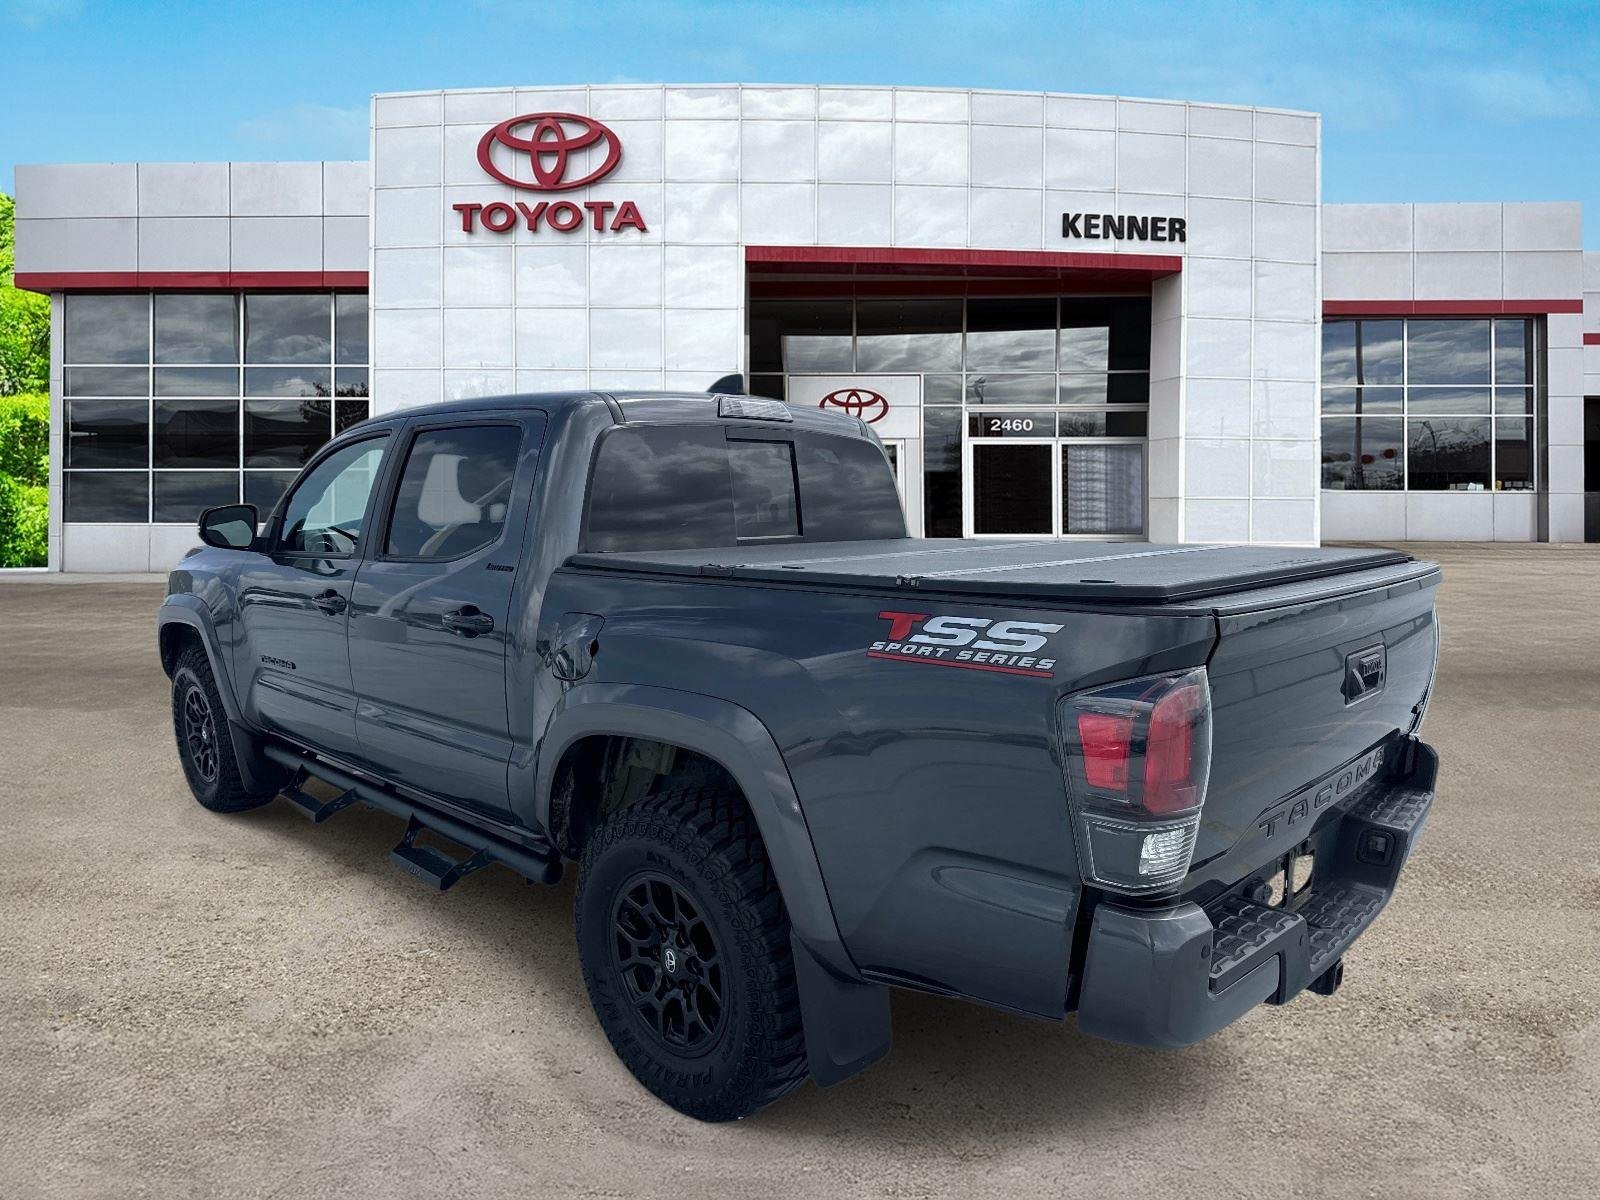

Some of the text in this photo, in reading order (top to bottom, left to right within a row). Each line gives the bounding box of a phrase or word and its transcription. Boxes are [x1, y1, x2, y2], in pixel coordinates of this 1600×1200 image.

[452, 201, 647, 232] TOYOTA
[1062, 213, 1187, 242] KENNER
[990, 418, 1033, 432] 2460
[878, 611, 1065, 653] TSS
[869, 641, 1057, 670] SPORT SERIES
[1258, 748, 1385, 840] TACOMA
